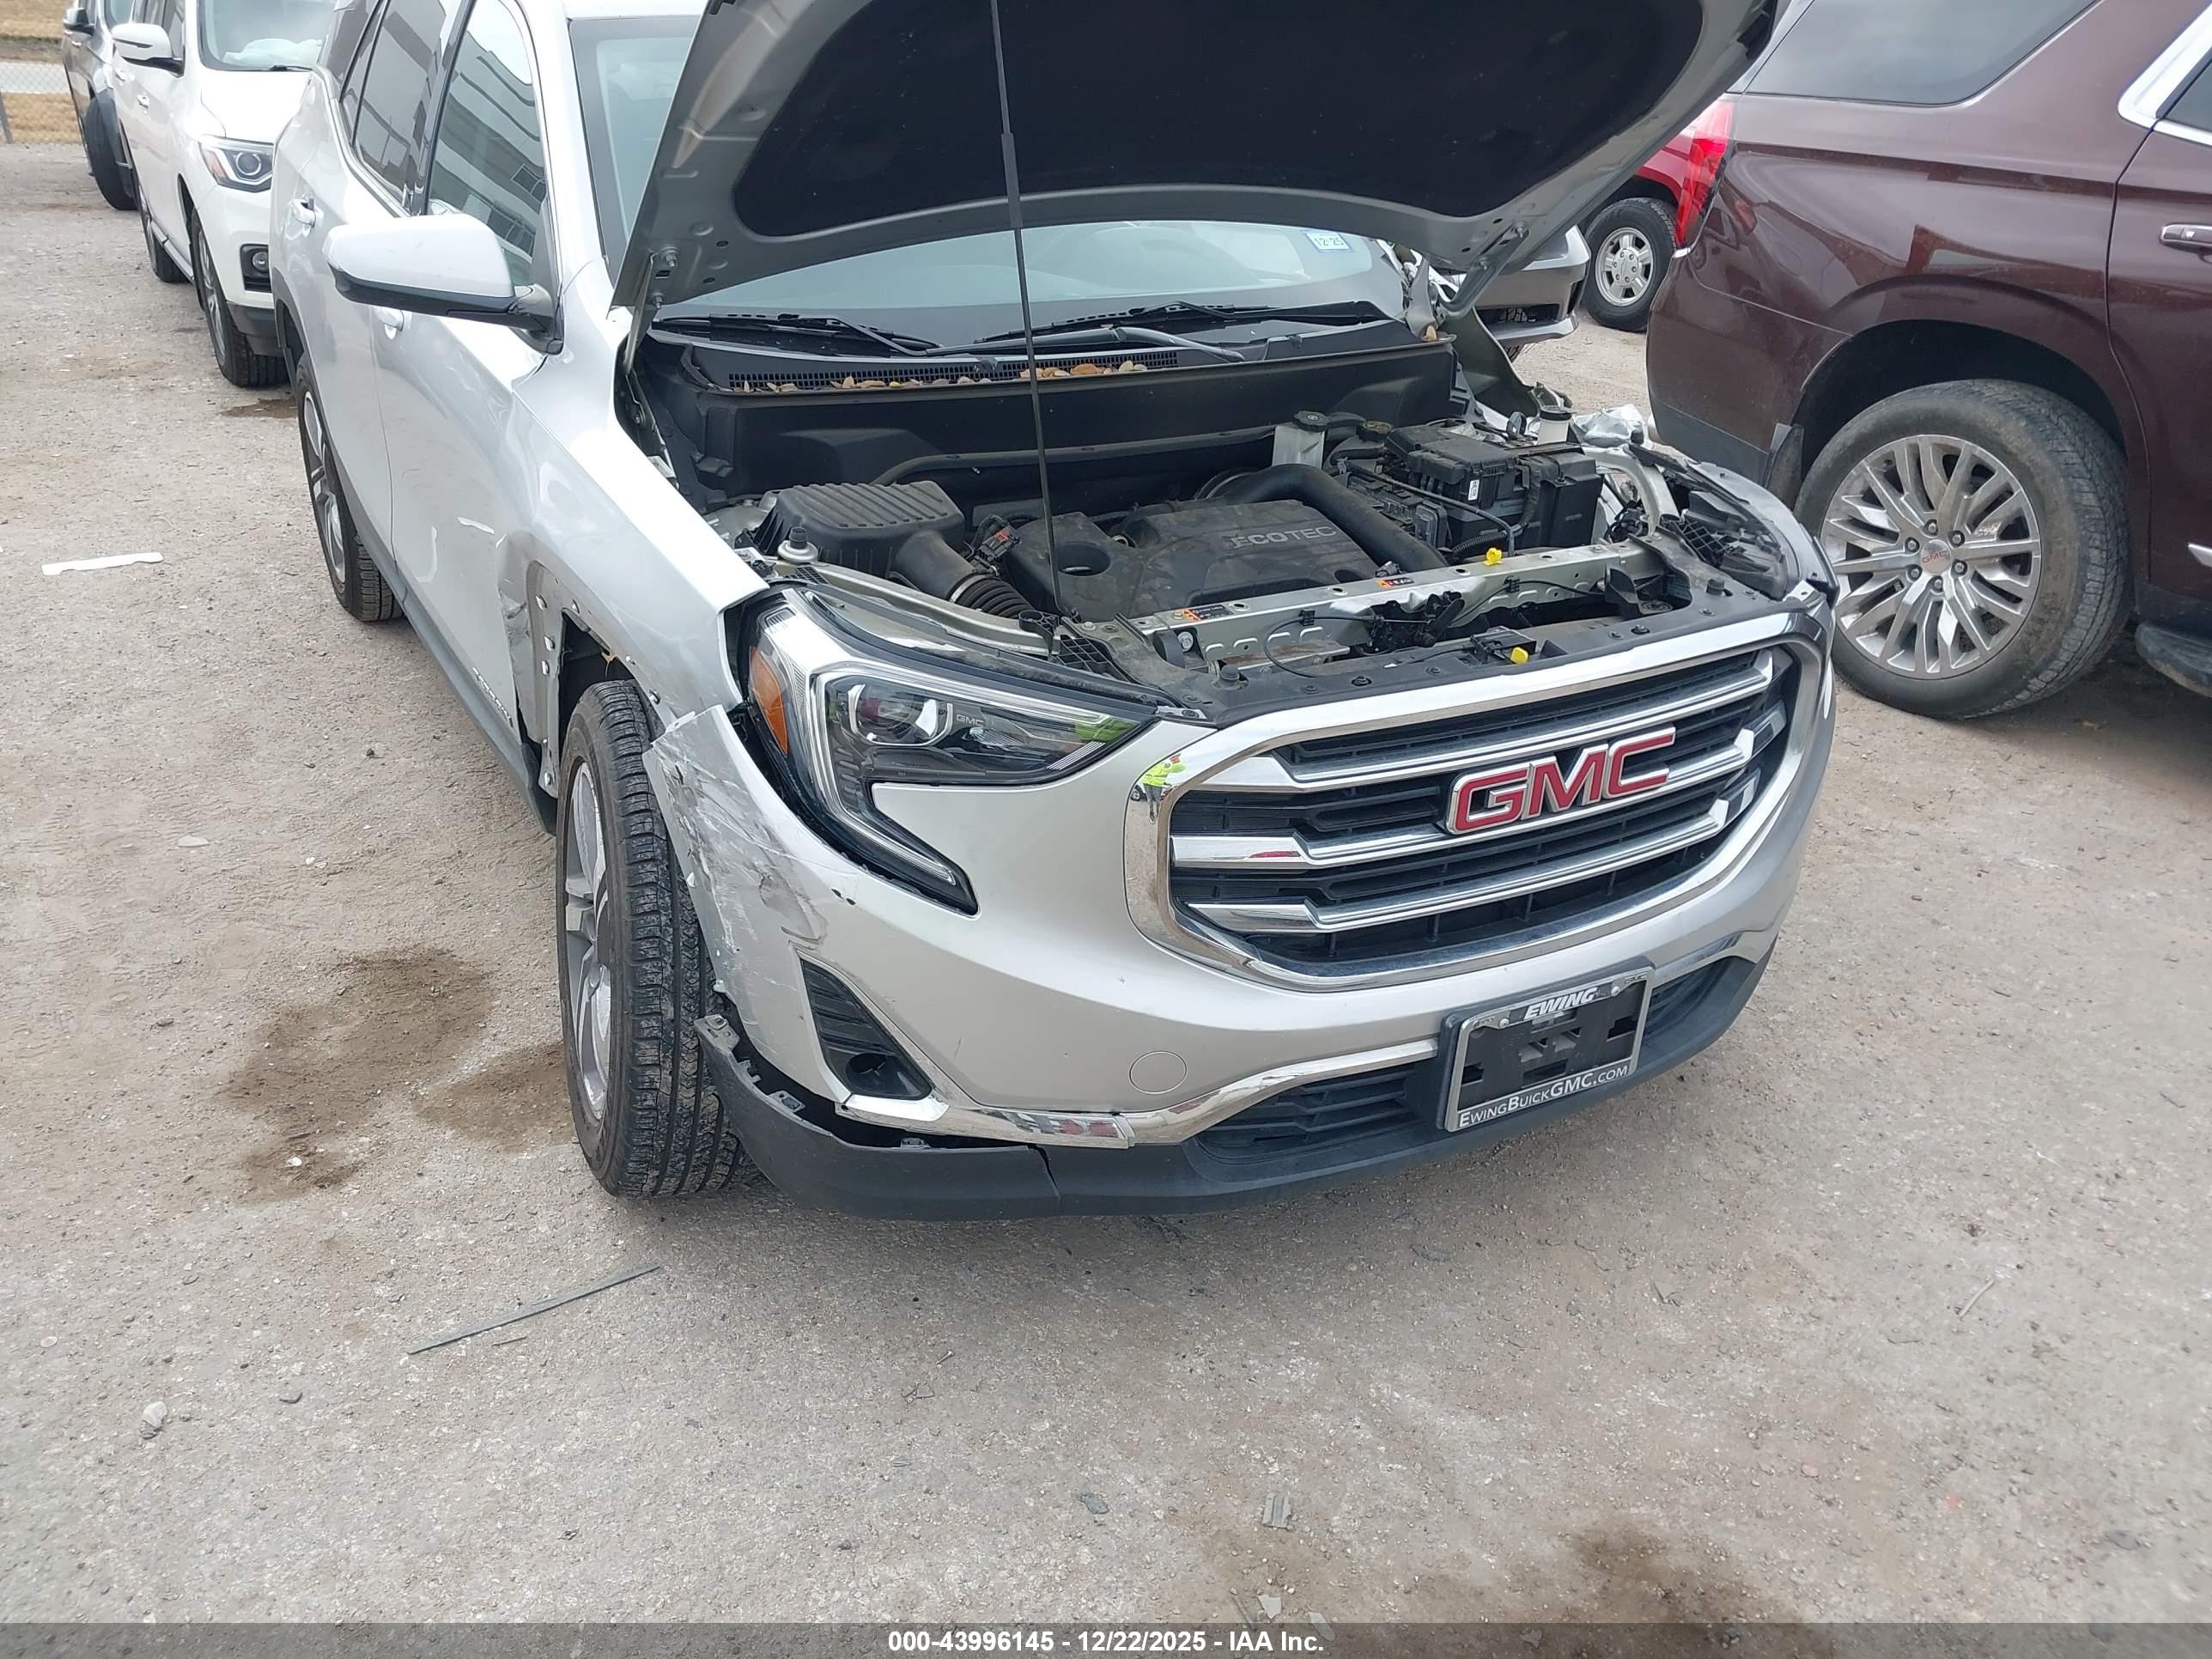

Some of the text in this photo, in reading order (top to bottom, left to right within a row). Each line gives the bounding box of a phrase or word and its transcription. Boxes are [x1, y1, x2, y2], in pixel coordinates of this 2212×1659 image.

[1231, 526, 1337, 549] ECOTEC
[1922, 550, 1947, 563] GMC
[956, 714, 984, 728] GMC
[1446, 726, 1676, 836] GMC
[1522, 988, 1599, 1021] EWING
